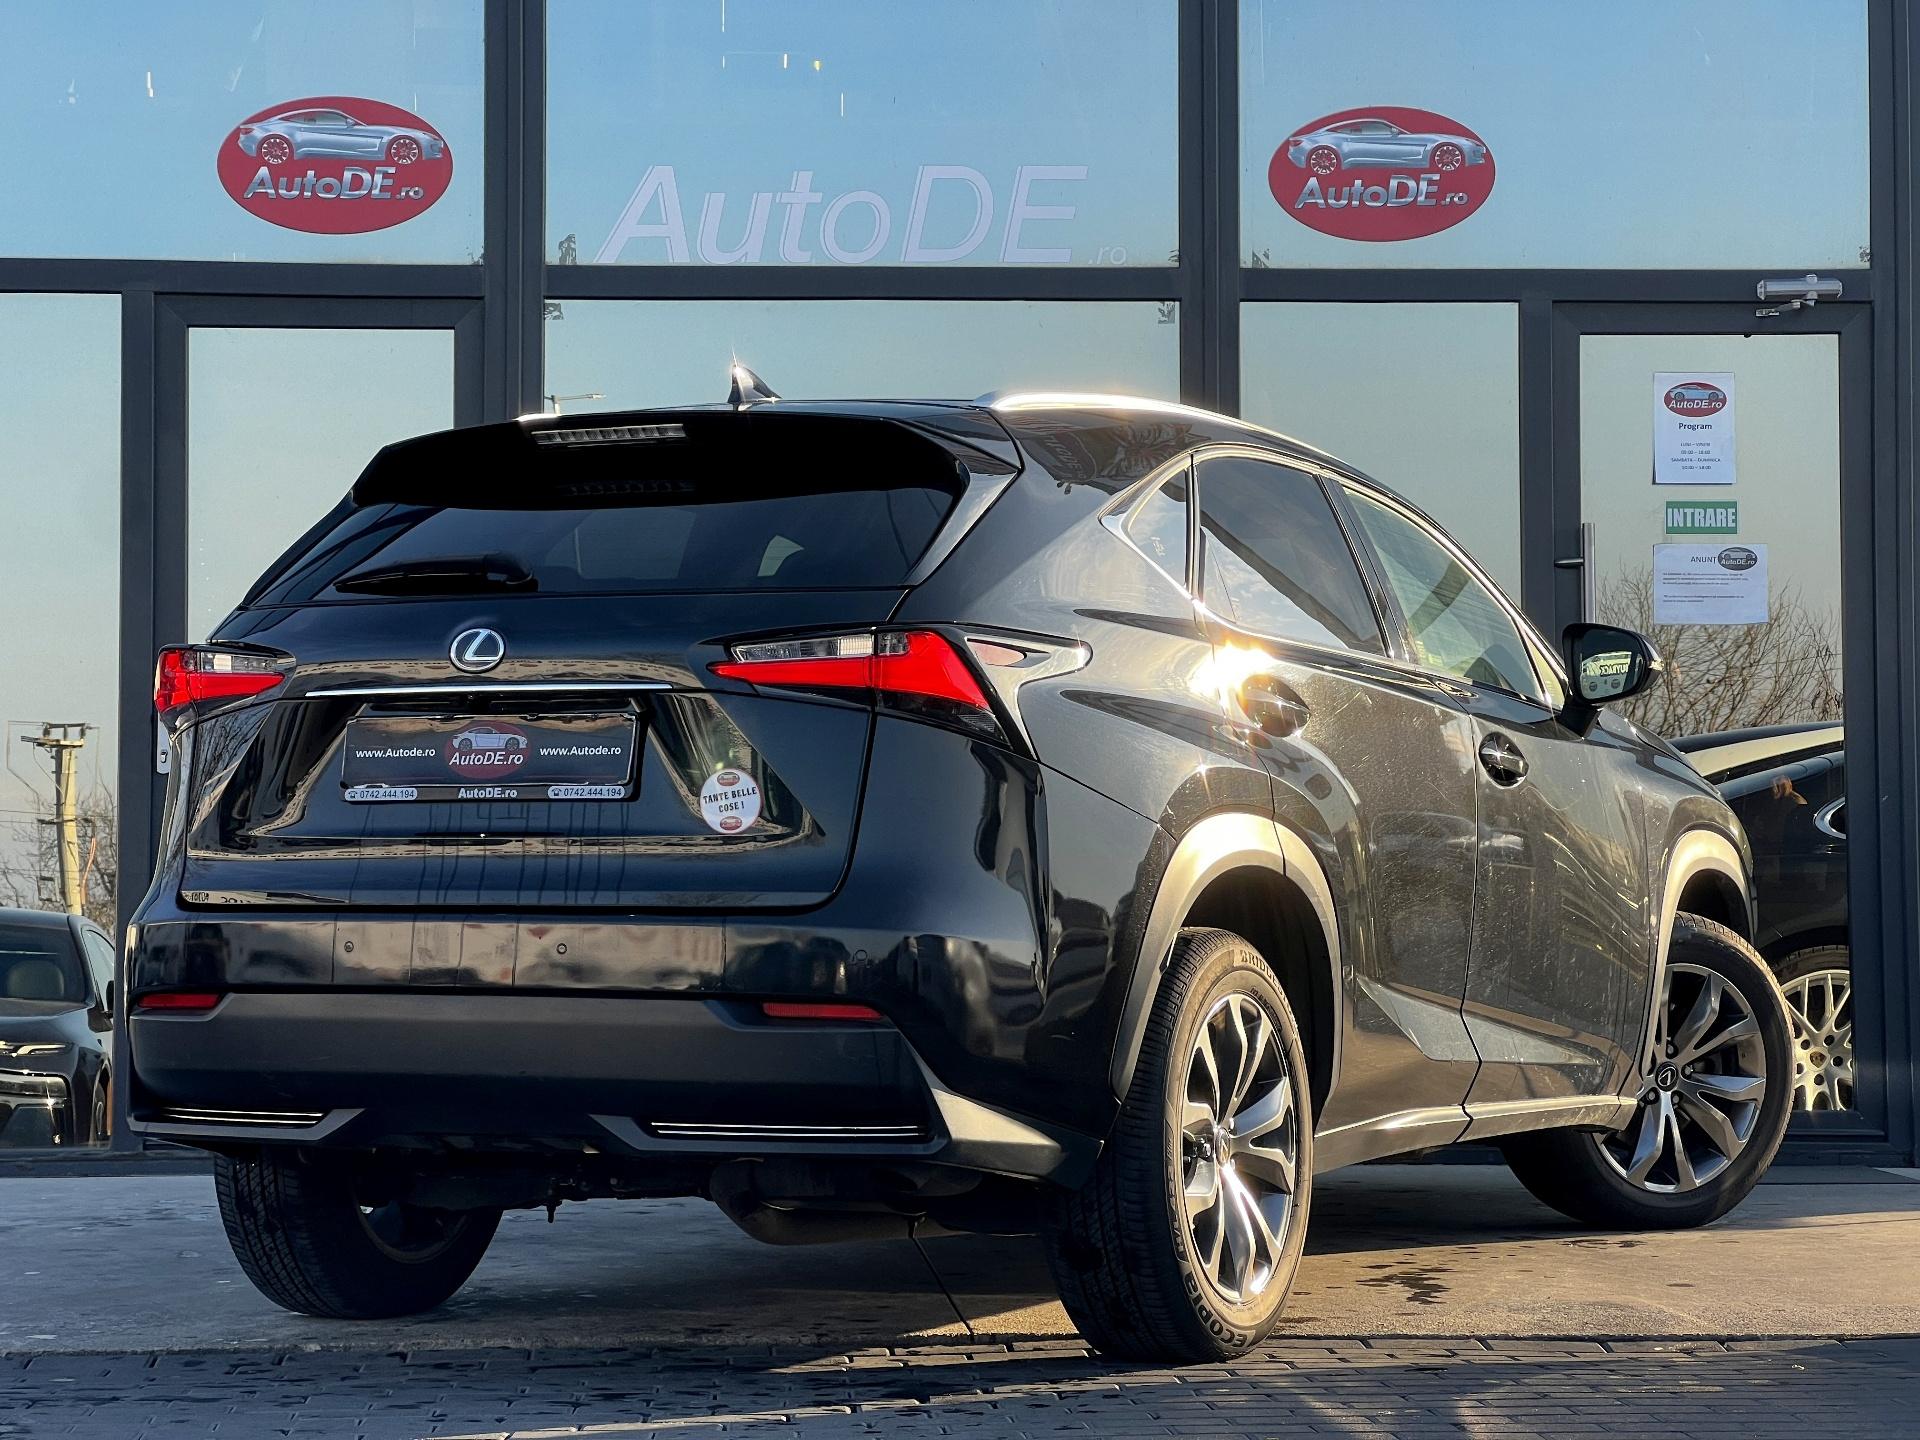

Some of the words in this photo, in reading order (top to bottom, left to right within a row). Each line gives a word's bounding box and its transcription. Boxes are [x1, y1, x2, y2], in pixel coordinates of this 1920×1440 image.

[1669, 400, 1723, 409] AutoDE.ro
[1678, 422, 1713, 431] Program
[1668, 508, 1736, 527] INTRARE
[355, 747, 436, 759] www.Autode.ro
[539, 745, 622, 757] www.Autode.ro
[448, 751, 525, 767] AutoDE.ro
[359, 789, 414, 799] 0742.444.194
[457, 787, 518, 799] AutoDE.ro
[563, 788, 622, 798] 0742.444.194
[703, 791, 730, 805] TANTE
[731, 786, 758, 799] BELLE
[718, 801, 740, 813] COSE
[1184, 1271, 1248, 1348] ECOPIA
